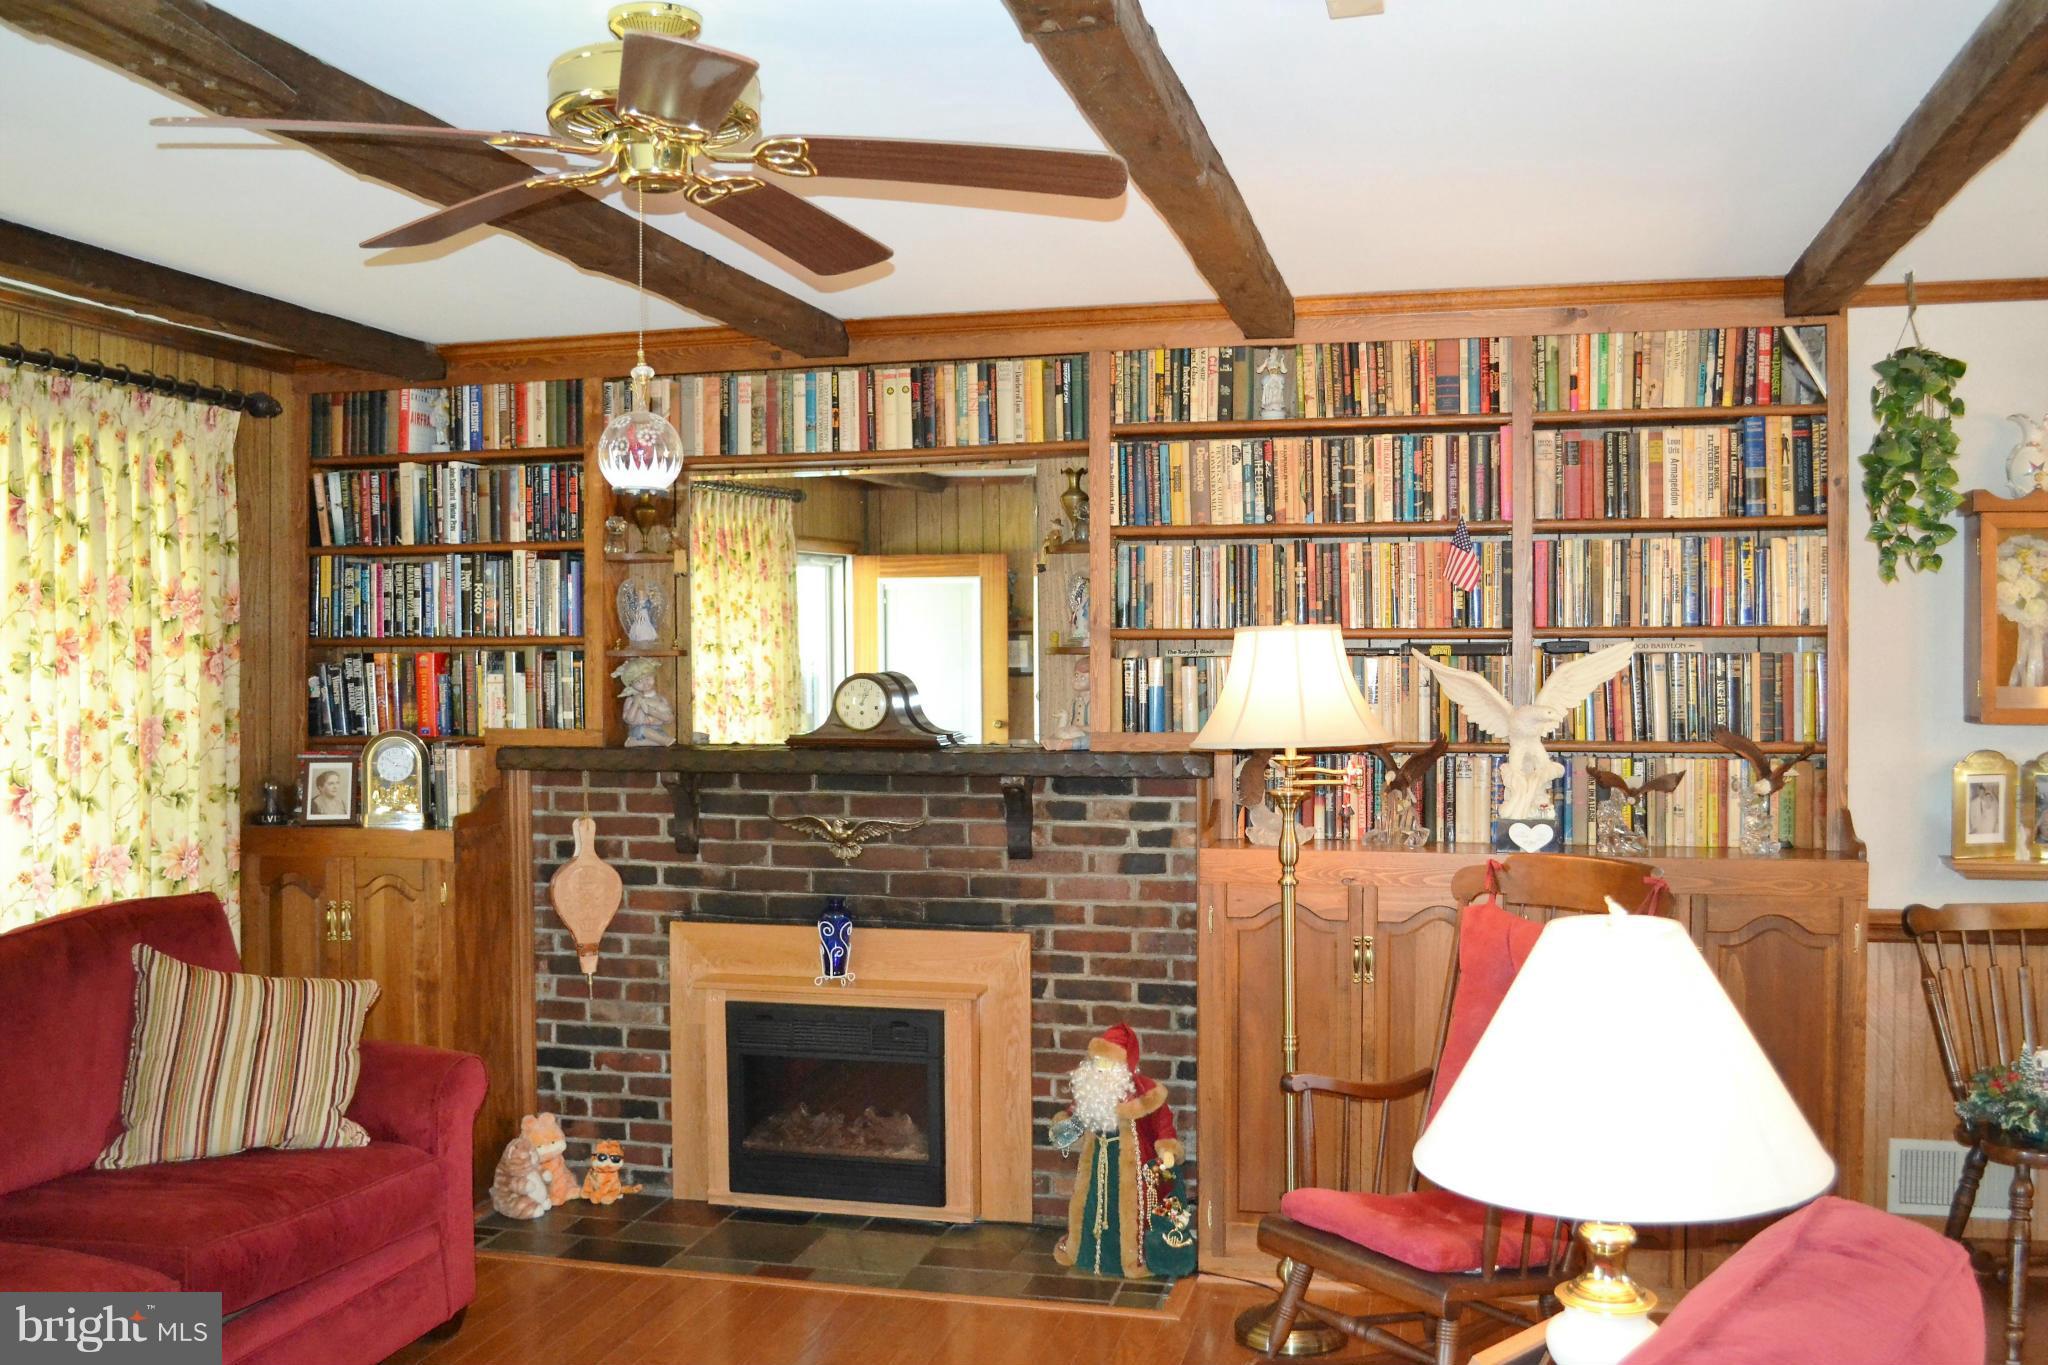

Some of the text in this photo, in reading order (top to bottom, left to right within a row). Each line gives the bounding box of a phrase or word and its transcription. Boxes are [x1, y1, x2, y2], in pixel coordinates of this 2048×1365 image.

[410, 411, 433, 428] AIRFRA
[470, 402, 479, 432] EXCLUSIVE
[1668, 458, 1680, 506] Armageddon
[474, 583, 484, 615] KOKO
[1183, 574, 1191, 597] WYLIE
[1716, 679, 1726, 726] NIGHT PREY
